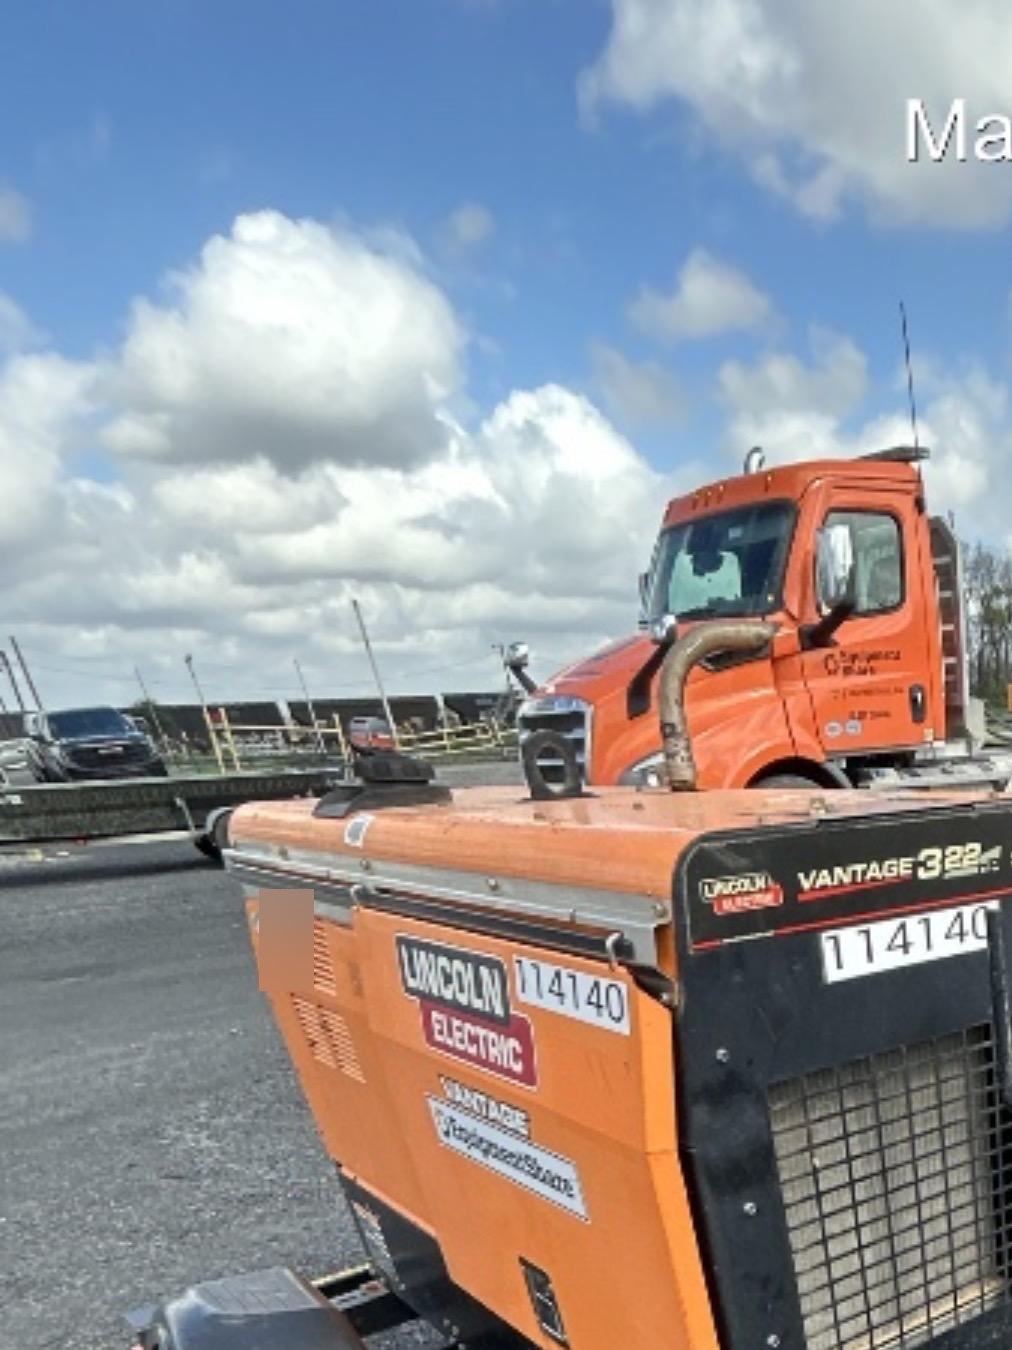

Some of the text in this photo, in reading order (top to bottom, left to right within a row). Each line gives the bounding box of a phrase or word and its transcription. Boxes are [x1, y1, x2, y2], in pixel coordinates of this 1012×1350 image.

[797, 856, 914, 891] VANTAGE
[825, 905, 989, 970] 114140
[401, 944, 505, 1018] LINCOLN
[515, 959, 625, 1024] 114140
[430, 1010, 524, 1074] ELECTRIC
